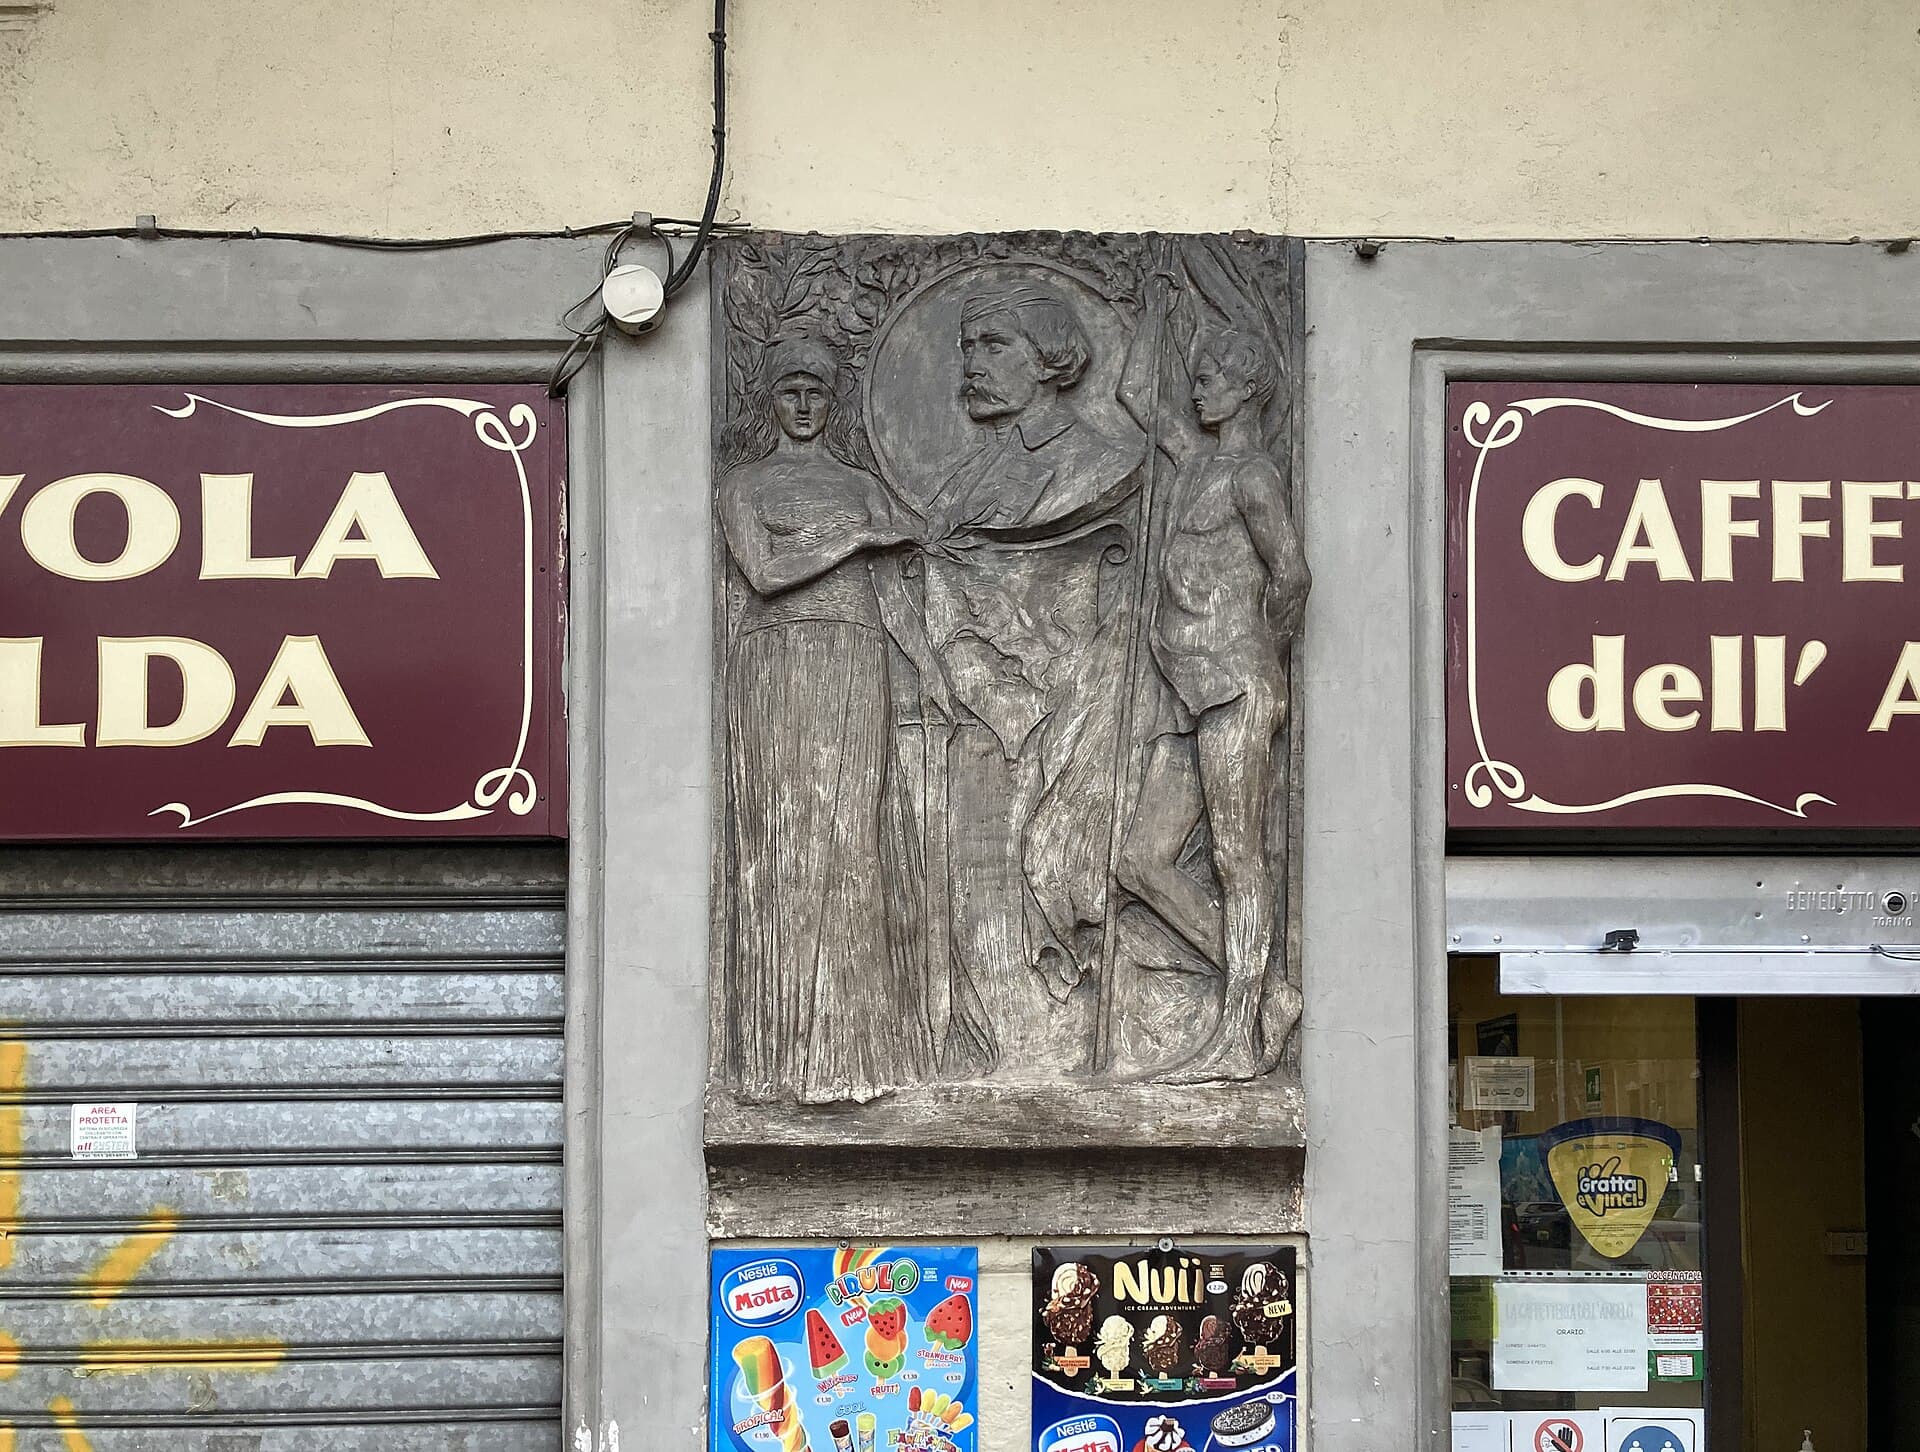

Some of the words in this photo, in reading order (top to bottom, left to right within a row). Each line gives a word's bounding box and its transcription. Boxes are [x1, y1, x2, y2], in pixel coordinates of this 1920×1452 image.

[0, 472, 440, 581] OLA
[1522, 477, 1920, 583] CAFFE
[1546, 634, 1828, 732] dell'
[1873, 916, 1912, 927] TORINO
[79, 1116, 128, 1124] PROTETTA
[1580, 1176, 1637, 1193] Gratta
[950, 1278, 969, 1290] New
[735, 1286, 795, 1312] Motta
[1268, 1304, 1286, 1315] NEW
[734, 1409, 784, 1434] TROPICAL
